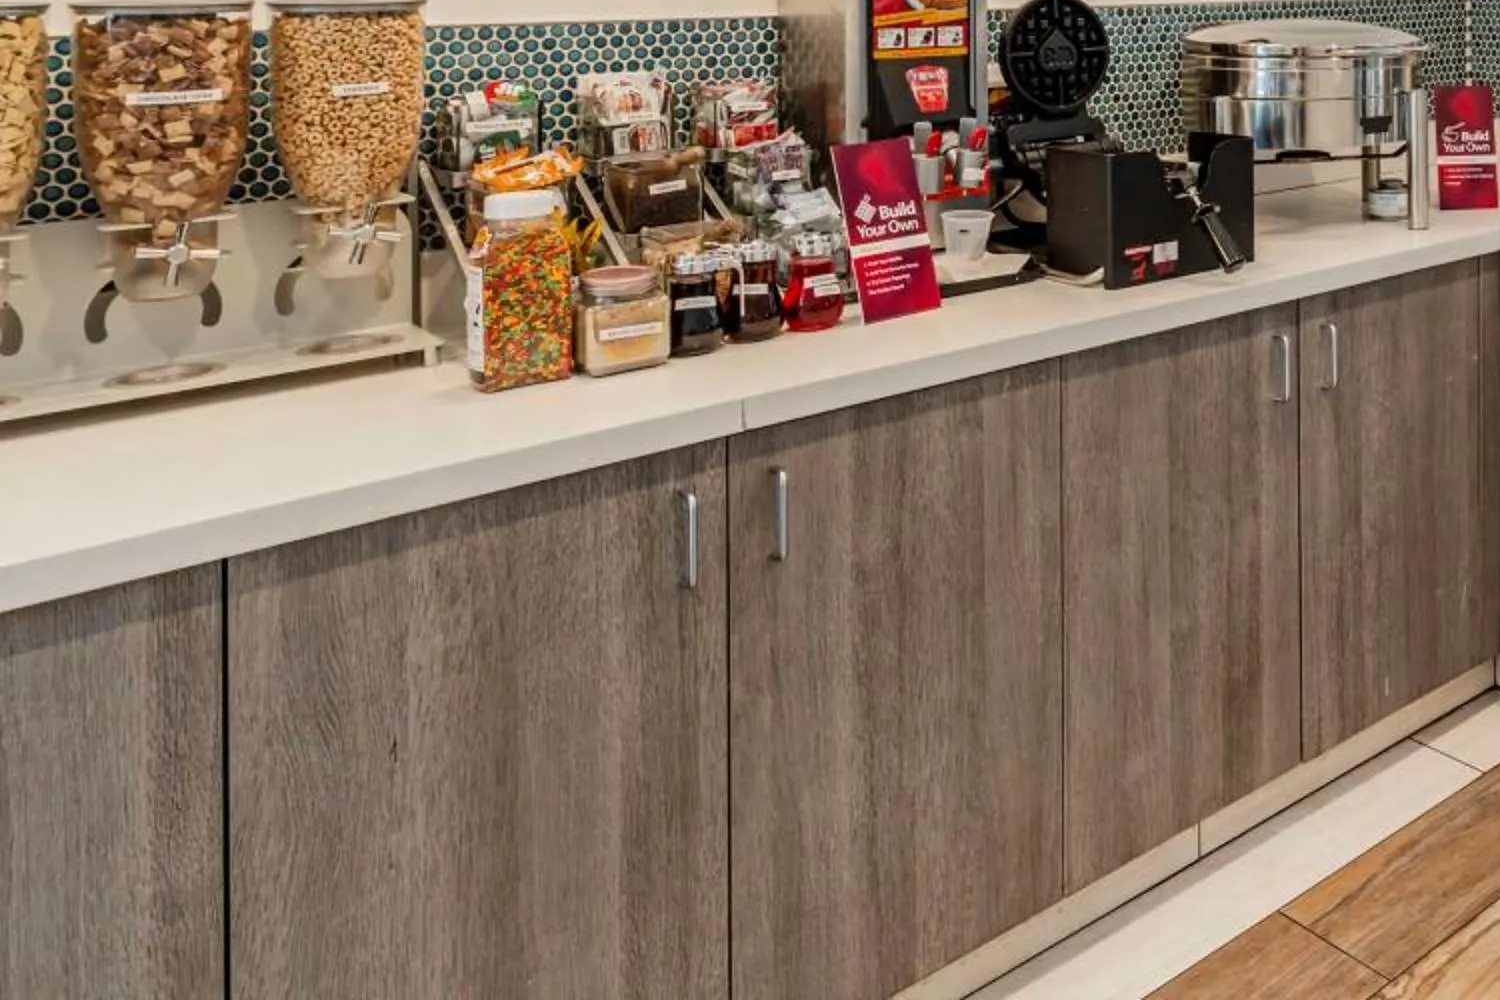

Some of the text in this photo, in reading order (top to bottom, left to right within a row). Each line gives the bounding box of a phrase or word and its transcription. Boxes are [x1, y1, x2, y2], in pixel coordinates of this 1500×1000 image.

[1461, 129, 1490, 142] Build
[1443, 141, 1491, 153] Your Own
[878, 200, 917, 220] Build
[856, 219, 919, 239] Your Own
